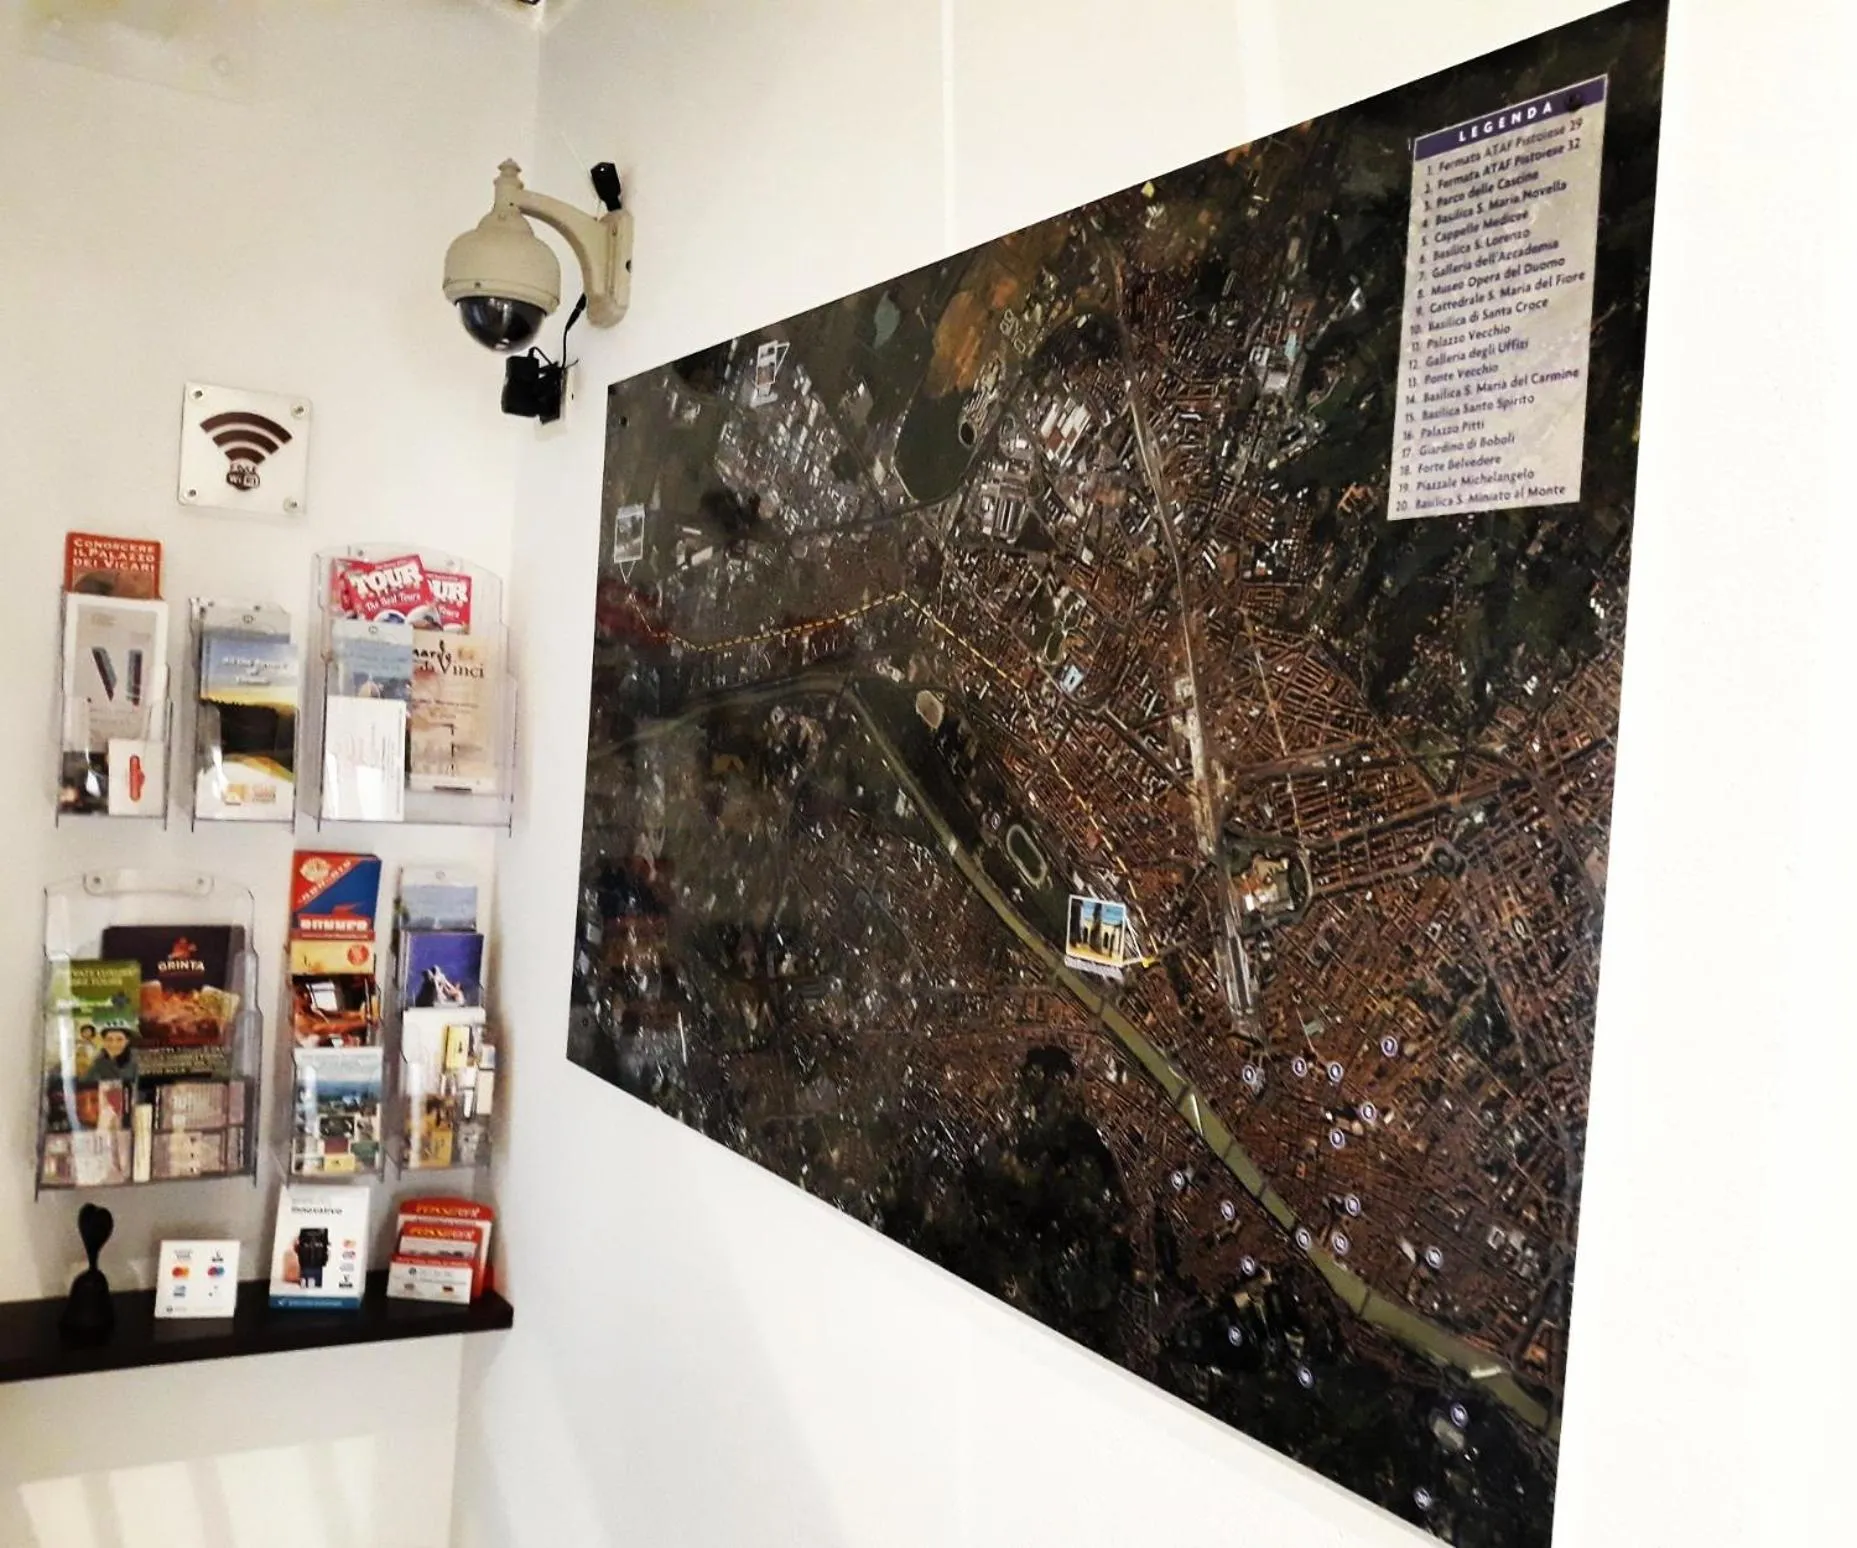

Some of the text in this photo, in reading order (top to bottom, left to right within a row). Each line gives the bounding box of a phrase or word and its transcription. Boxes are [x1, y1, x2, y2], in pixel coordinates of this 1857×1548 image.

[1458, 102, 1552, 142] LEGENDA
[1438, 153, 1481, 172] Fermata
[1484, 140, 1512, 158] ATAF
[1516, 126, 1565, 148] Pistoiese
[1570, 118, 1583, 132] 29
[1438, 171, 1480, 189] Fermata
[1482, 157, 1512, 176] ATAF
[1515, 145, 1564, 167] Pistoiese
[1567, 138, 1581, 151] 32
[1436, 207, 1473, 226] Basilica
[1488, 195, 1520, 211] Maria
[1522, 180, 1566, 202] Novella
[1437, 193, 1465, 208] Parco
[1467, 183, 1494, 199] delle
[1498, 171, 1539, 189] Cascine
[1435, 222, 1479, 244] Cappelle
[1482, 210, 1528, 229] Medicee
[1434, 243, 1470, 261] Basilica
[1486, 229, 1530, 248] Lorenzo
[1431, 281, 1465, 297] Museo
[1467, 272, 1500, 289] Opera
[1504, 263, 1521, 279] del
[1524, 257, 1566, 275] Duomo
[1432, 261, 1472, 279] Galleria
[1430, 293, 1485, 314] Cattedrale
[1500, 283, 1531, 298] Maria
[1534, 275, 1553, 291] del
[1556, 271, 1585, 287] Fiore
[1428, 316, 1466, 332] Basilica
[1469, 310, 1479, 324] di
[1482, 305, 1513, 321] Santa
[1515, 298, 1549, 314] Croce
[1427, 333, 1466, 350] Palazzo
[1468, 323, 1512, 342] Vecchio
[1425, 351, 1467, 368] Galleria
[1469, 342, 1496, 361] degli
[1498, 338, 1529, 354] Uffizi
[1424, 372, 1455, 385] Ponte
[1457, 362, 1499, 379] Vecchio
[1424, 386, 1462, 404] Basilica
[1476, 379, 1508, 394] Maria
[1511, 374, 1529, 389] del
[1531, 368, 1580, 385] Carmine
[1422, 405, 1461, 421] Basilica
[1463, 401, 1495, 415] Santo
[1497, 394, 1535, 412] Spirito
[1421, 424, 1460, 438] Palazzo
[1462, 419, 1485, 433] Pitti
[1419, 441, 1465, 457] Giardino
[1467, 437, 1477, 450] di
[1480, 431, 1515, 449] Boboli
[1418, 461, 1445, 474] Forte
[1447, 454, 1502, 471] Belvedere
[1416, 477, 1457, 491] Piazzale
[1460, 467, 1535, 485] Michelangelo
[1415, 496, 1454, 510] Basilica
[1467, 490, 1512, 503] Miniato
[1513, 486, 1525, 499] al
[1527, 484, 1566, 498] Monte
[73, 538, 155, 553] CONOSCERE
[73, 548, 155, 563] IL PALAZZO
[73, 558, 155, 573] DEI VICARI
[157, 960, 205, 972] GRINTA
